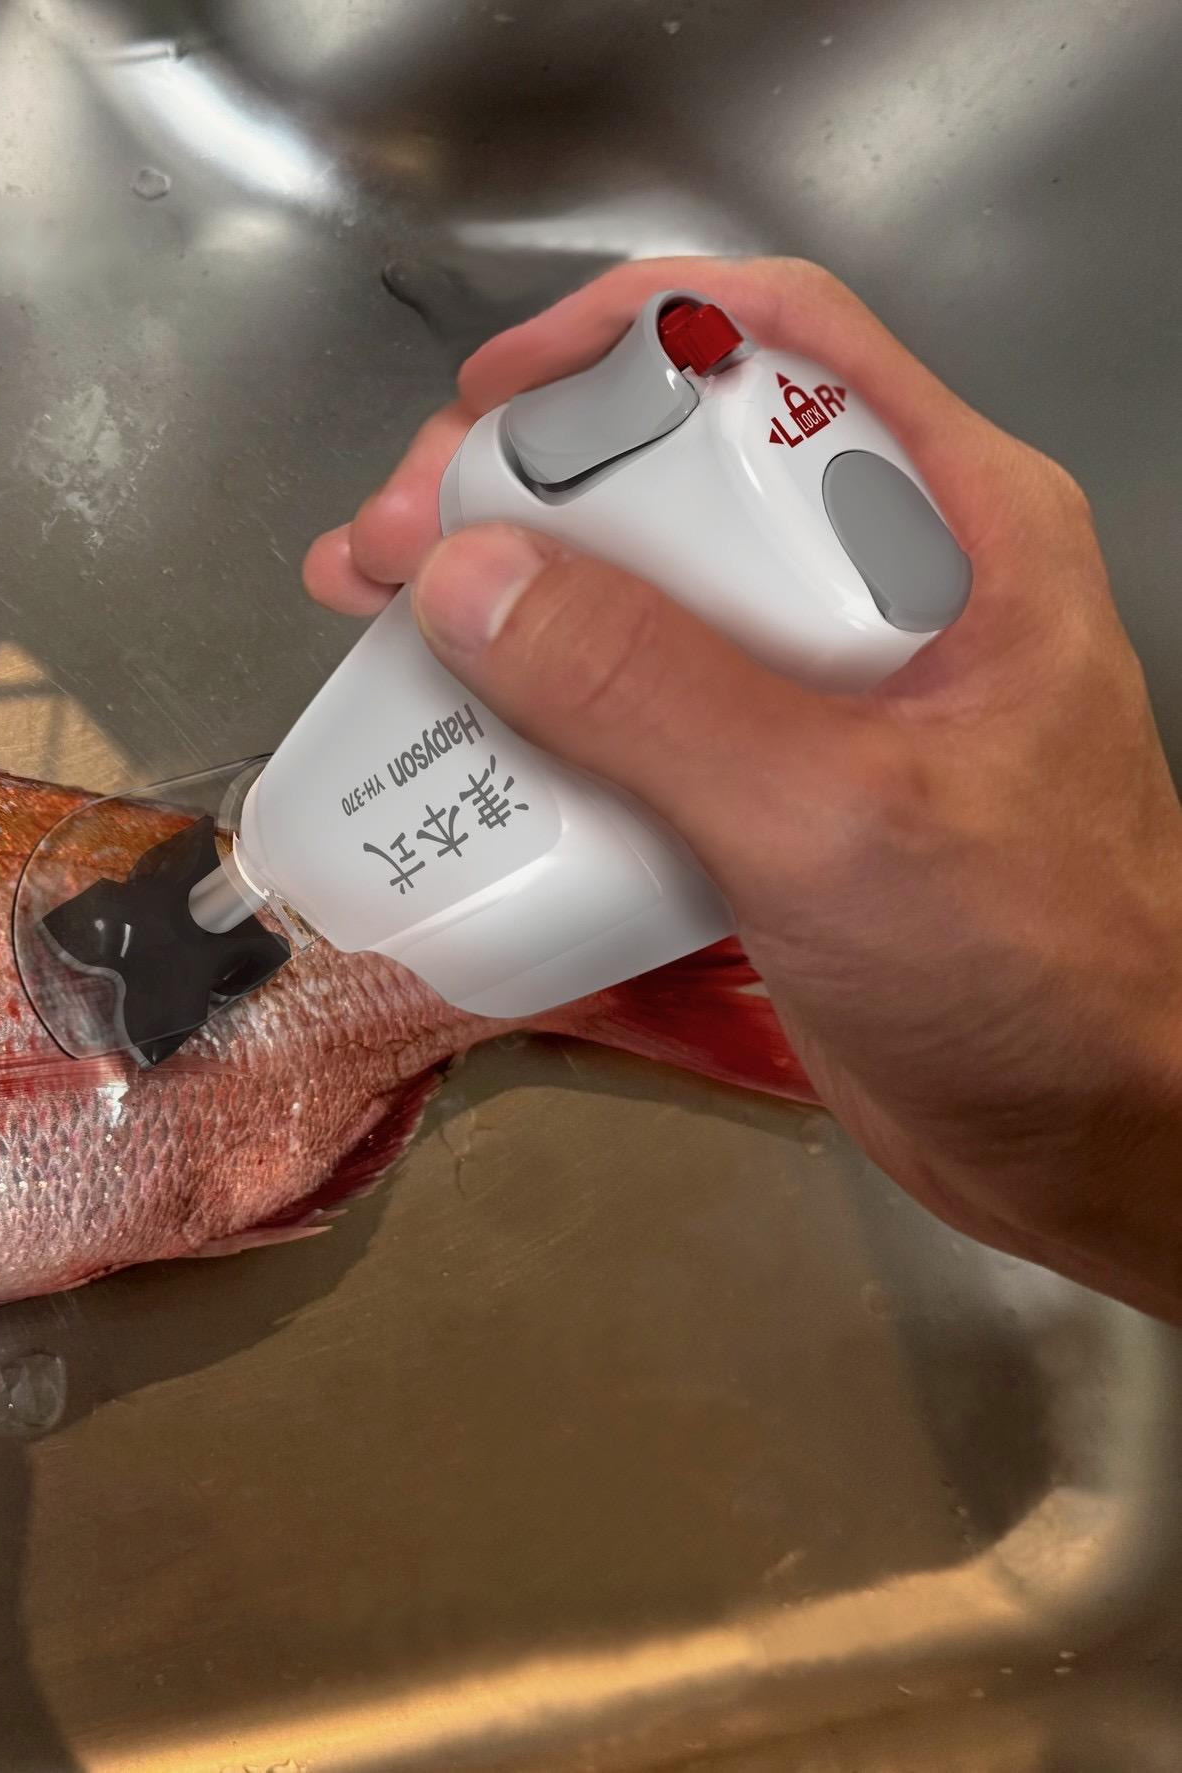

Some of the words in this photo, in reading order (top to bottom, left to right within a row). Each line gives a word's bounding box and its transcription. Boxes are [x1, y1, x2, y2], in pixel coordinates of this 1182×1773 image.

[796, 405, 825, 432] LOCK
[813, 384, 846, 418] R
[771, 417, 804, 448] L
[386, 703, 485, 787] Hapyson
[341, 774, 386, 816] YH-370
[363, 754, 529, 894] 津本式
